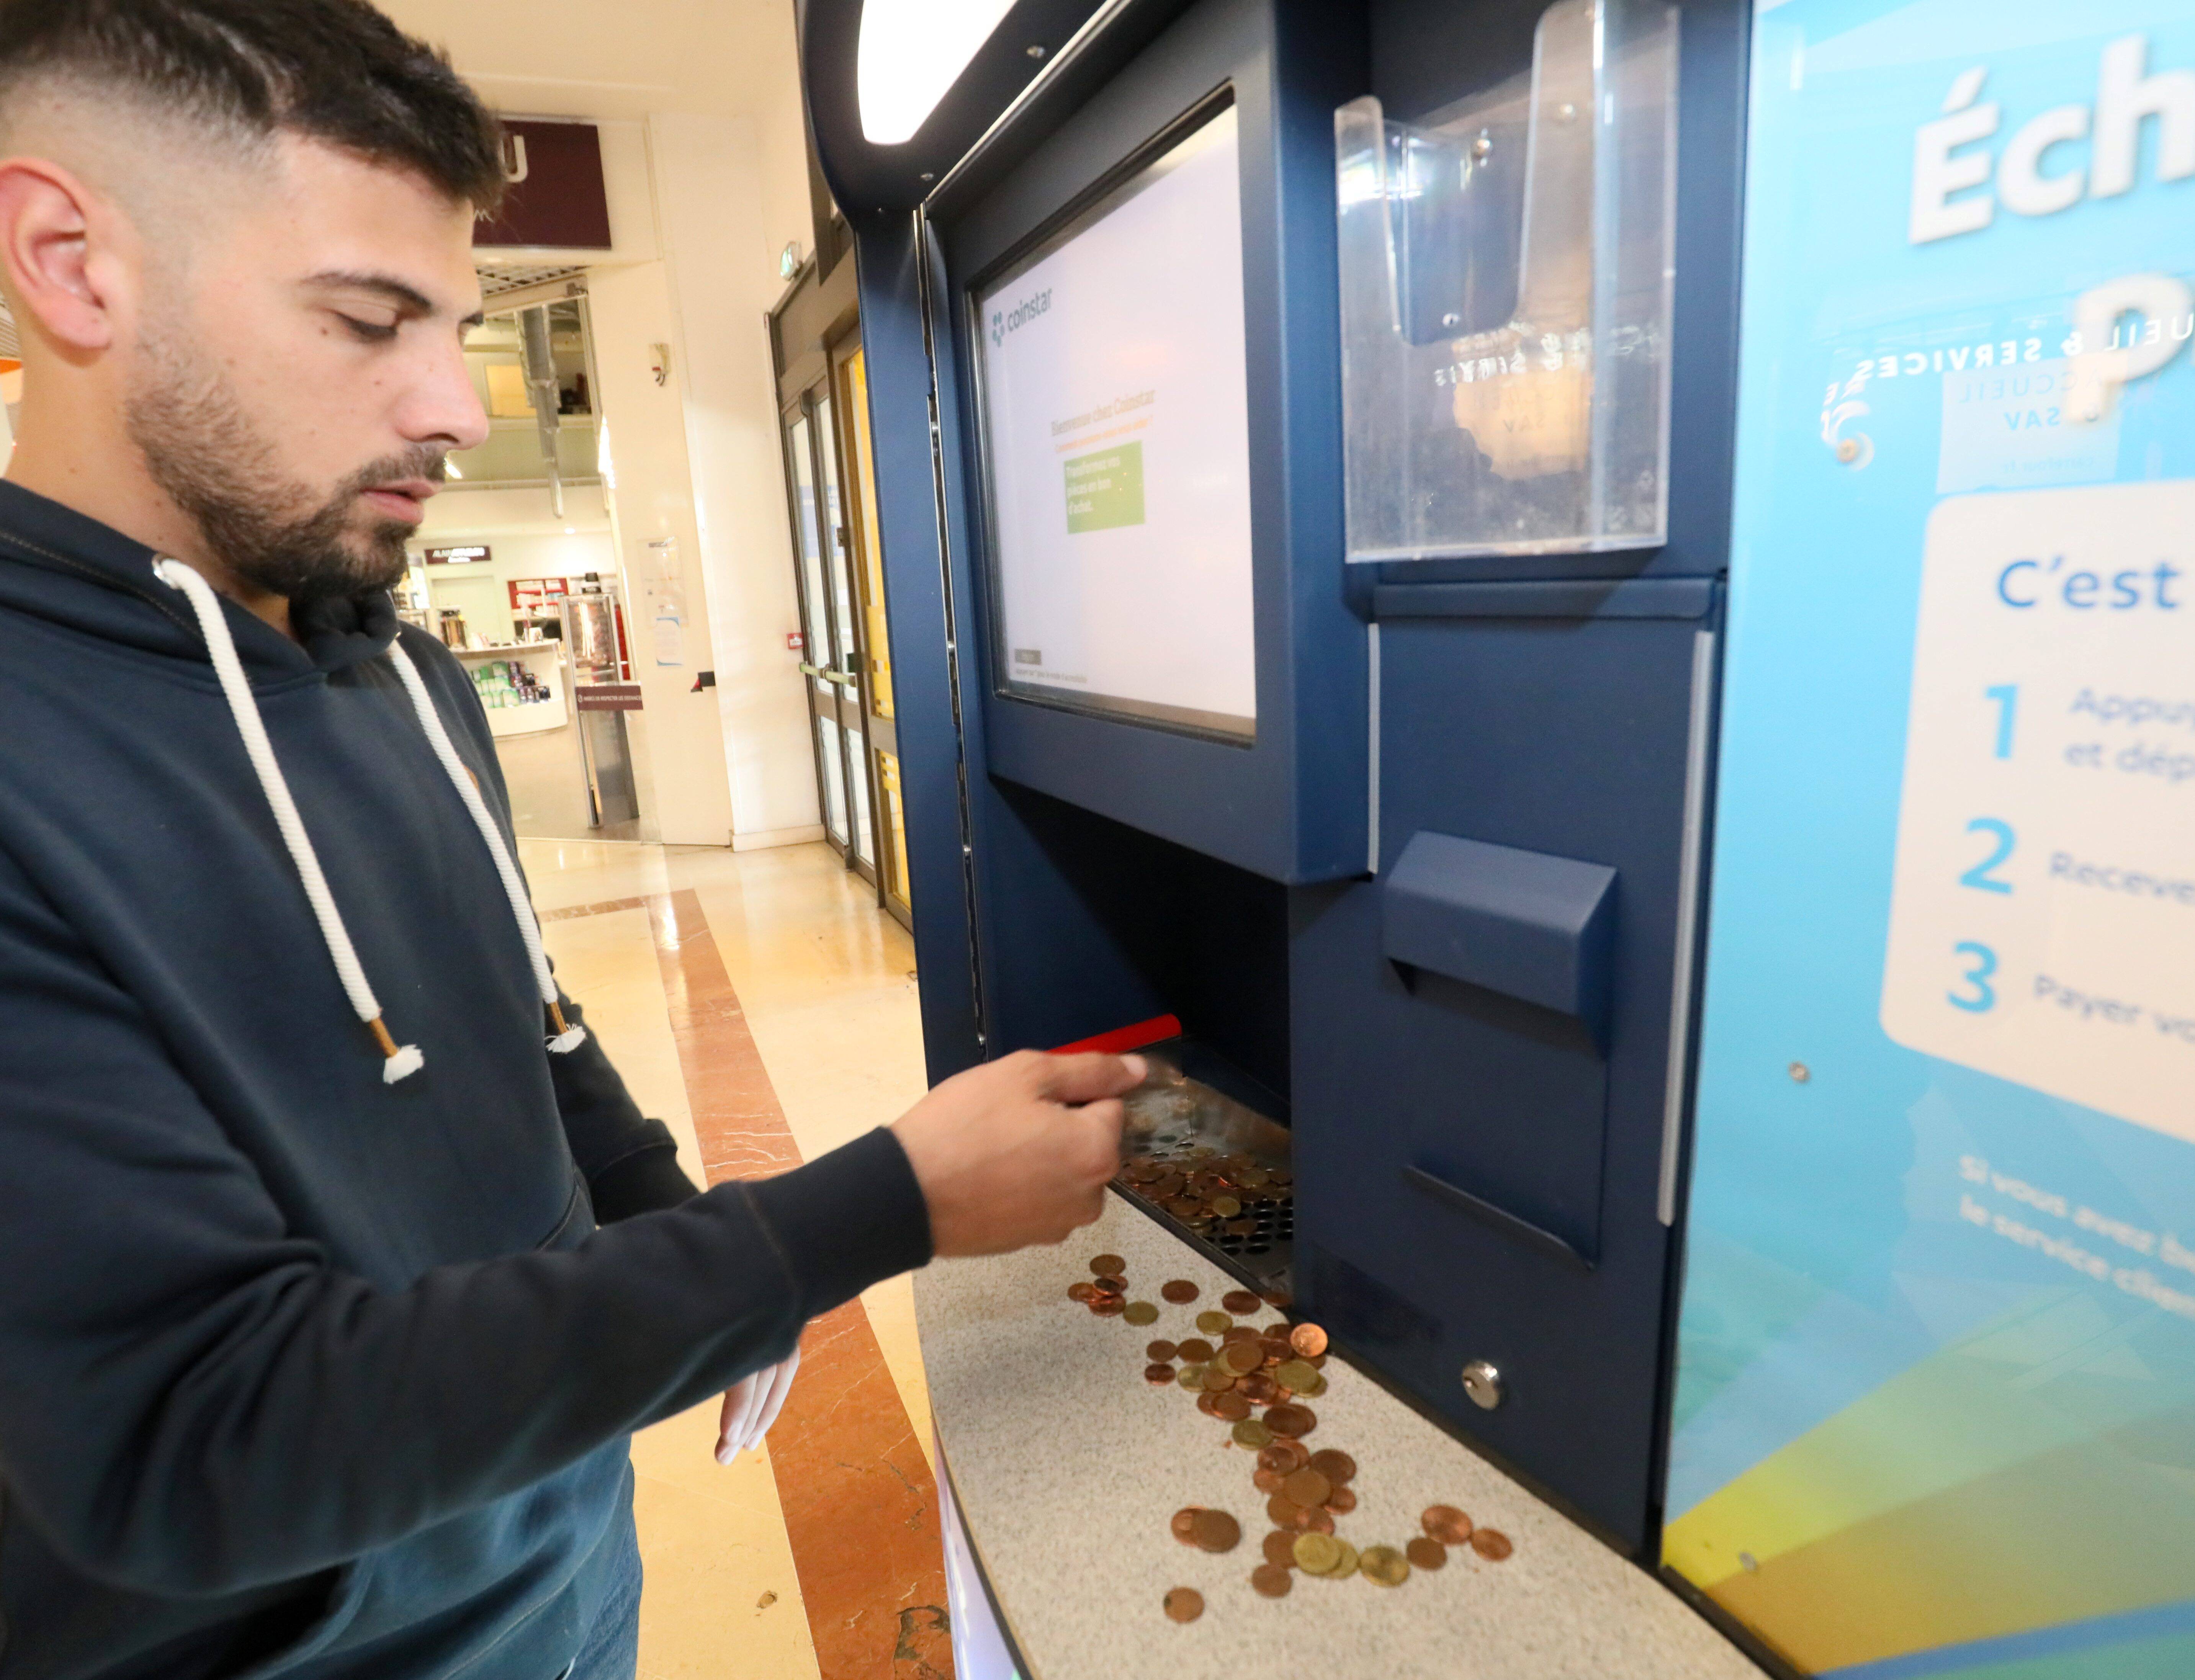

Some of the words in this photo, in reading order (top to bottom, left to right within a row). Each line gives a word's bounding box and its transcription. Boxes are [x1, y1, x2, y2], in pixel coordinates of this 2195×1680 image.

[1007, 288, 1053, 332] coinstar
[1997, 555, 2181, 610] C'est
[1984, 683, 2020, 760] 1
[1958, 817, 2018, 895] 2
[1946, 940, 2000, 1015] 3
[2034, 974, 2141, 1023] Payer
